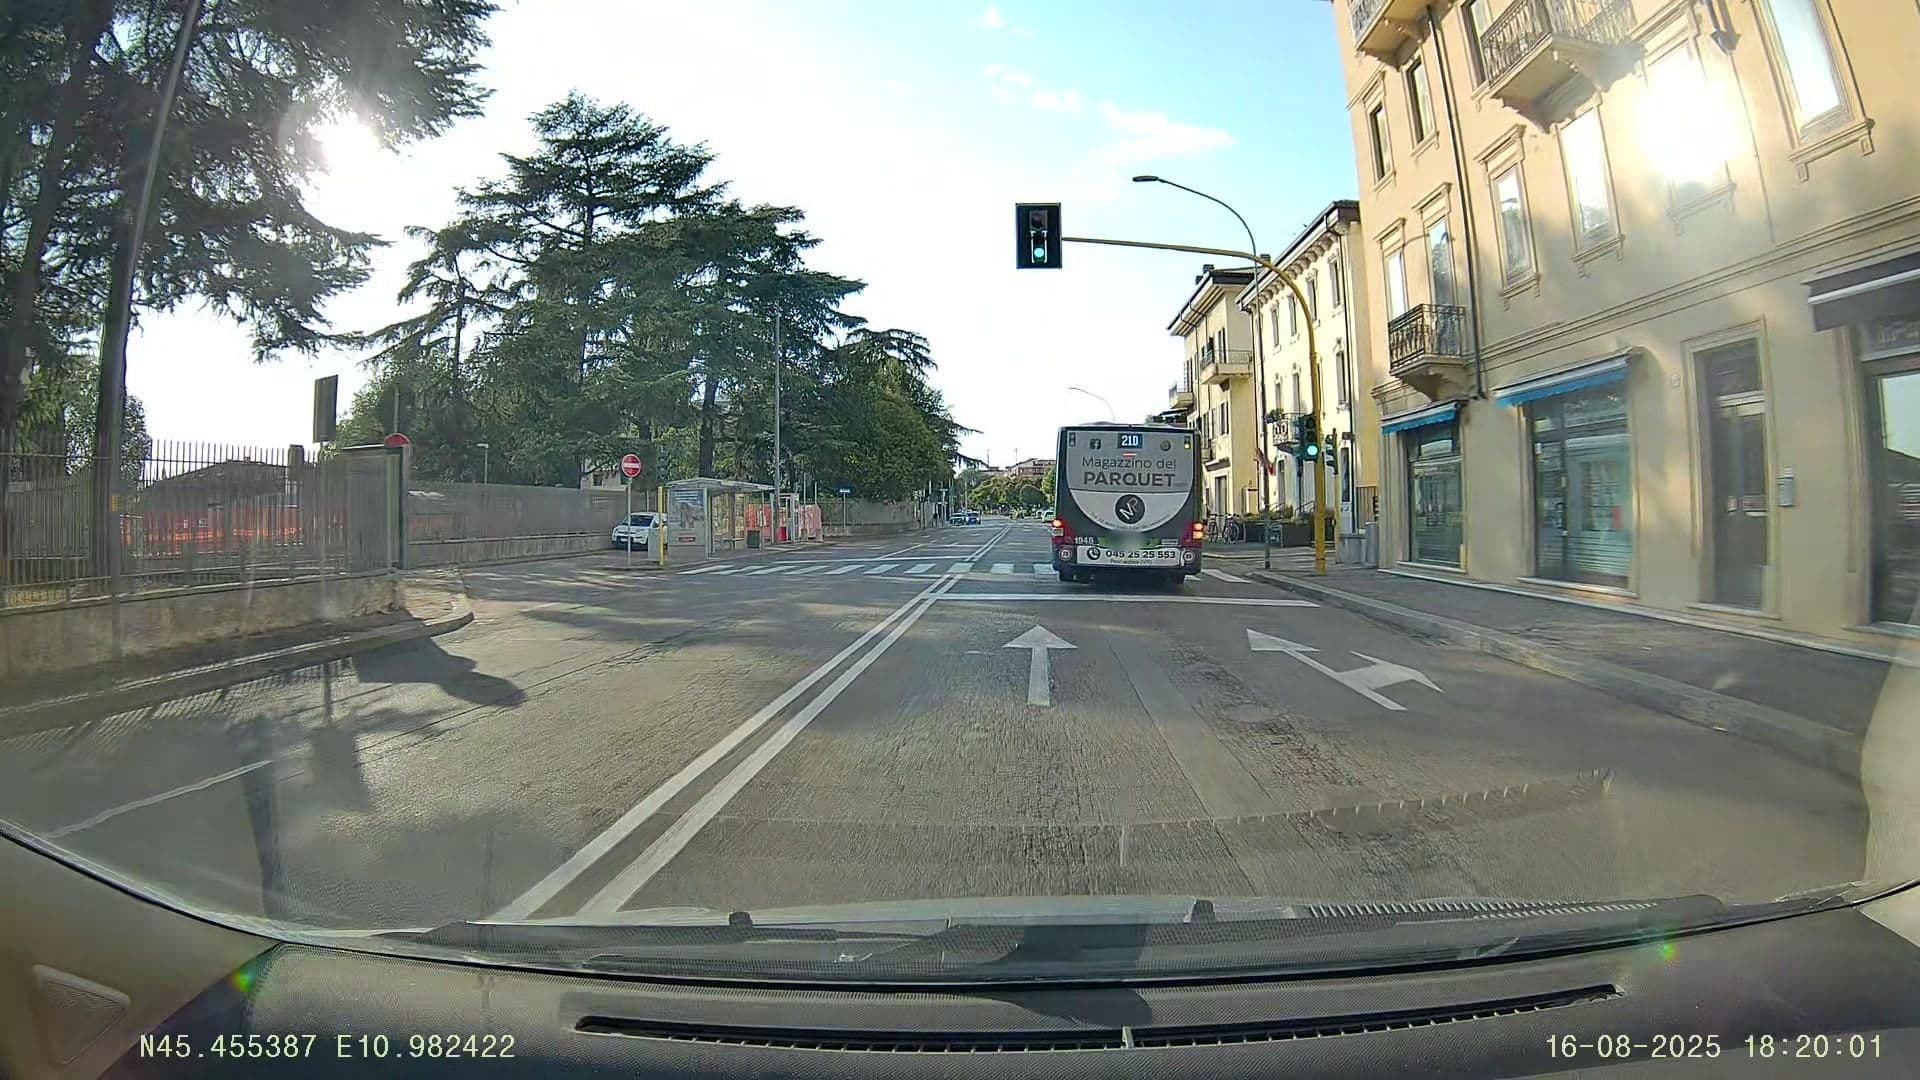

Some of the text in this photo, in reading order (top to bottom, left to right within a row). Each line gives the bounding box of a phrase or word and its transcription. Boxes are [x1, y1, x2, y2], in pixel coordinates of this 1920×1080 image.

[1082, 456, 1176, 470] Magazzino del
[1083, 472, 1175, 487] PARQUET
[1106, 550, 1125, 559] 045
[1128, 551, 1140, 559] 25
[1142, 551, 1155, 559] 25
[1157, 551, 1176, 560] 553
